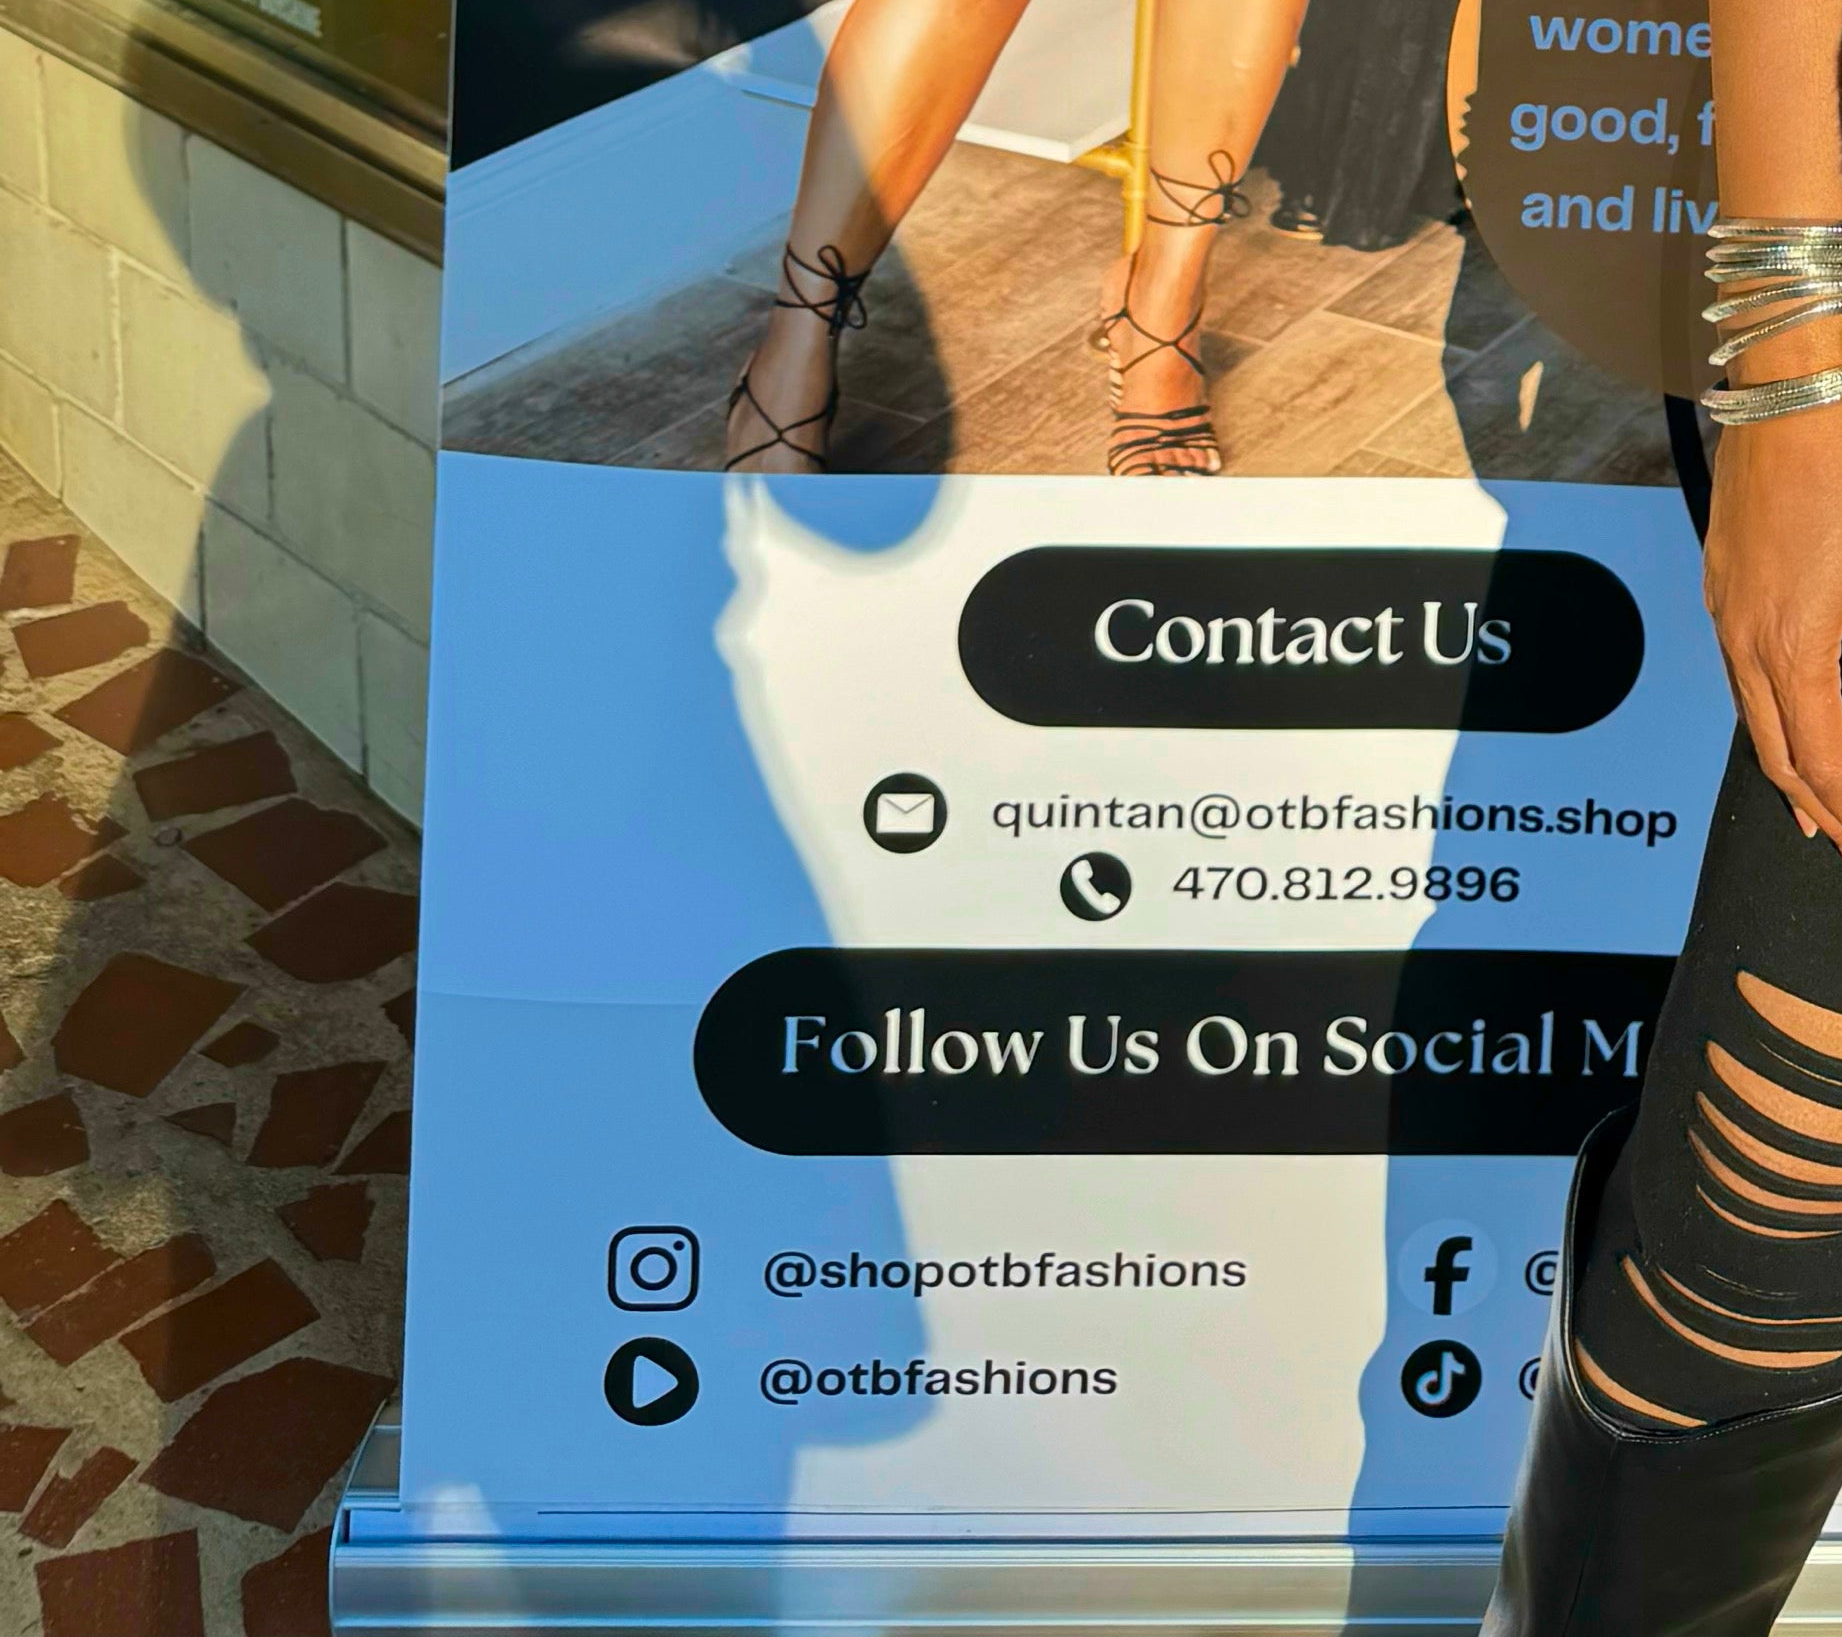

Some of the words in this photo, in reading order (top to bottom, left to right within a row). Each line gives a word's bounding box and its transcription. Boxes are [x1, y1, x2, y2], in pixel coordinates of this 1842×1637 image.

[1510, 97, 1680, 155] good,
[1521, 185, 1637, 233] and
[1094, 598, 1404, 667] Contact
[1421, 601, 1513, 667] Us
[992, 793, 1678, 847] quintan@otbfashions.shop
[1172, 865, 1521, 903] 470.812.9896
[780, 1008, 1044, 1077] Follow
[1066, 1014, 1160, 1077] Us
[1185, 1014, 1299, 1078] On
[1322, 1010, 1554, 1077] Social
[762, 1248, 1248, 1303] @shopotbfashions
[758, 1355, 1118, 1407] @otbfashions
